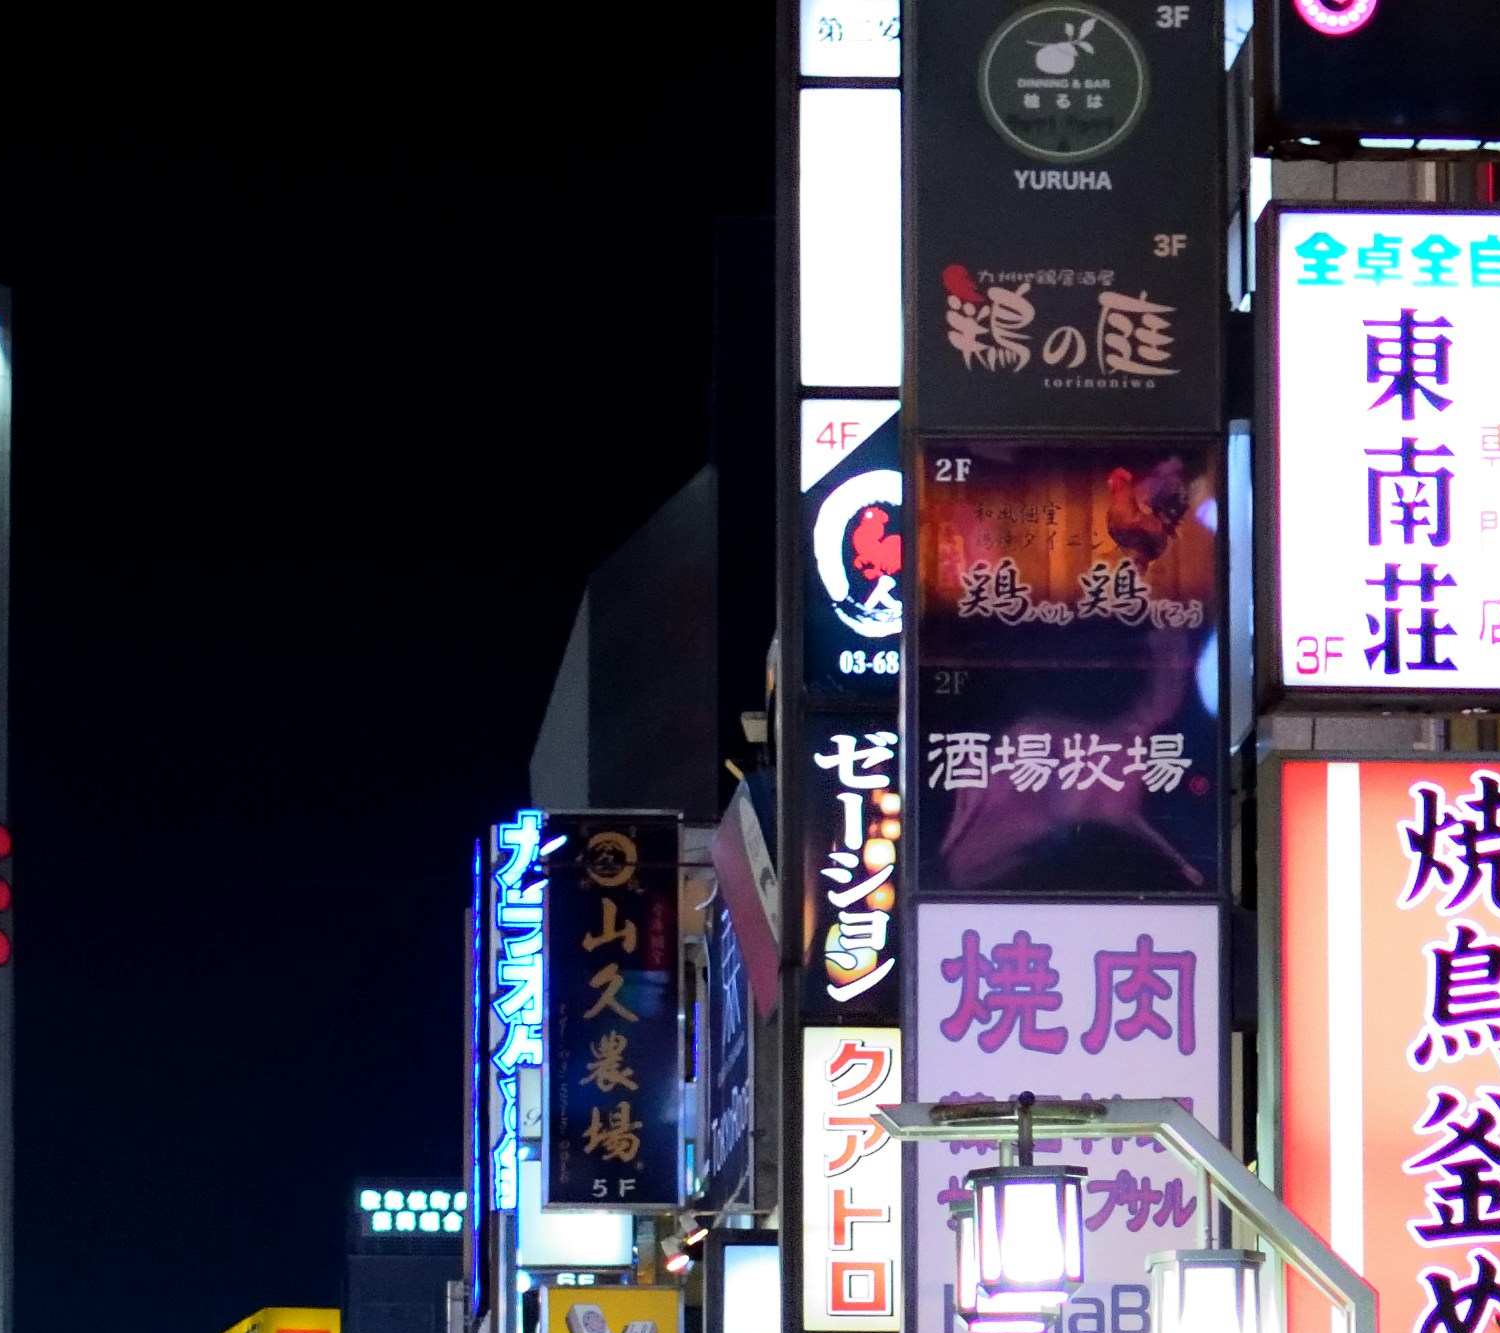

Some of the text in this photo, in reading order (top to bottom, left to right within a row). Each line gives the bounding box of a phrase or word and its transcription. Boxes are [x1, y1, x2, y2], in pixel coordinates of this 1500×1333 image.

[1156, 5, 1190, 29] 3F
[1084, 78, 1111, 89] BAR
[1014, 169, 1113, 192] YURUHA
[1153, 234, 1188, 258] 3F
[1044, 376, 1157, 391] torinoniwa
[815, 421, 861, 451] 4F
[935, 458, 972, 483] 2F
[1362, 306, 1459, 676] 東南荘
[1295, 634, 1346, 676] 3F
[934, 671, 969, 695] 2F
[926, 732, 1193, 793] 酒場牧場
[813, 732, 900, 1003] ゼーション
[940, 928, 1197, 1056] 焼肉
[579, 897, 644, 1164] 山久農場
[591, 1177, 637, 1198] 5F
[822, 1039, 894, 1317] クアトロ
